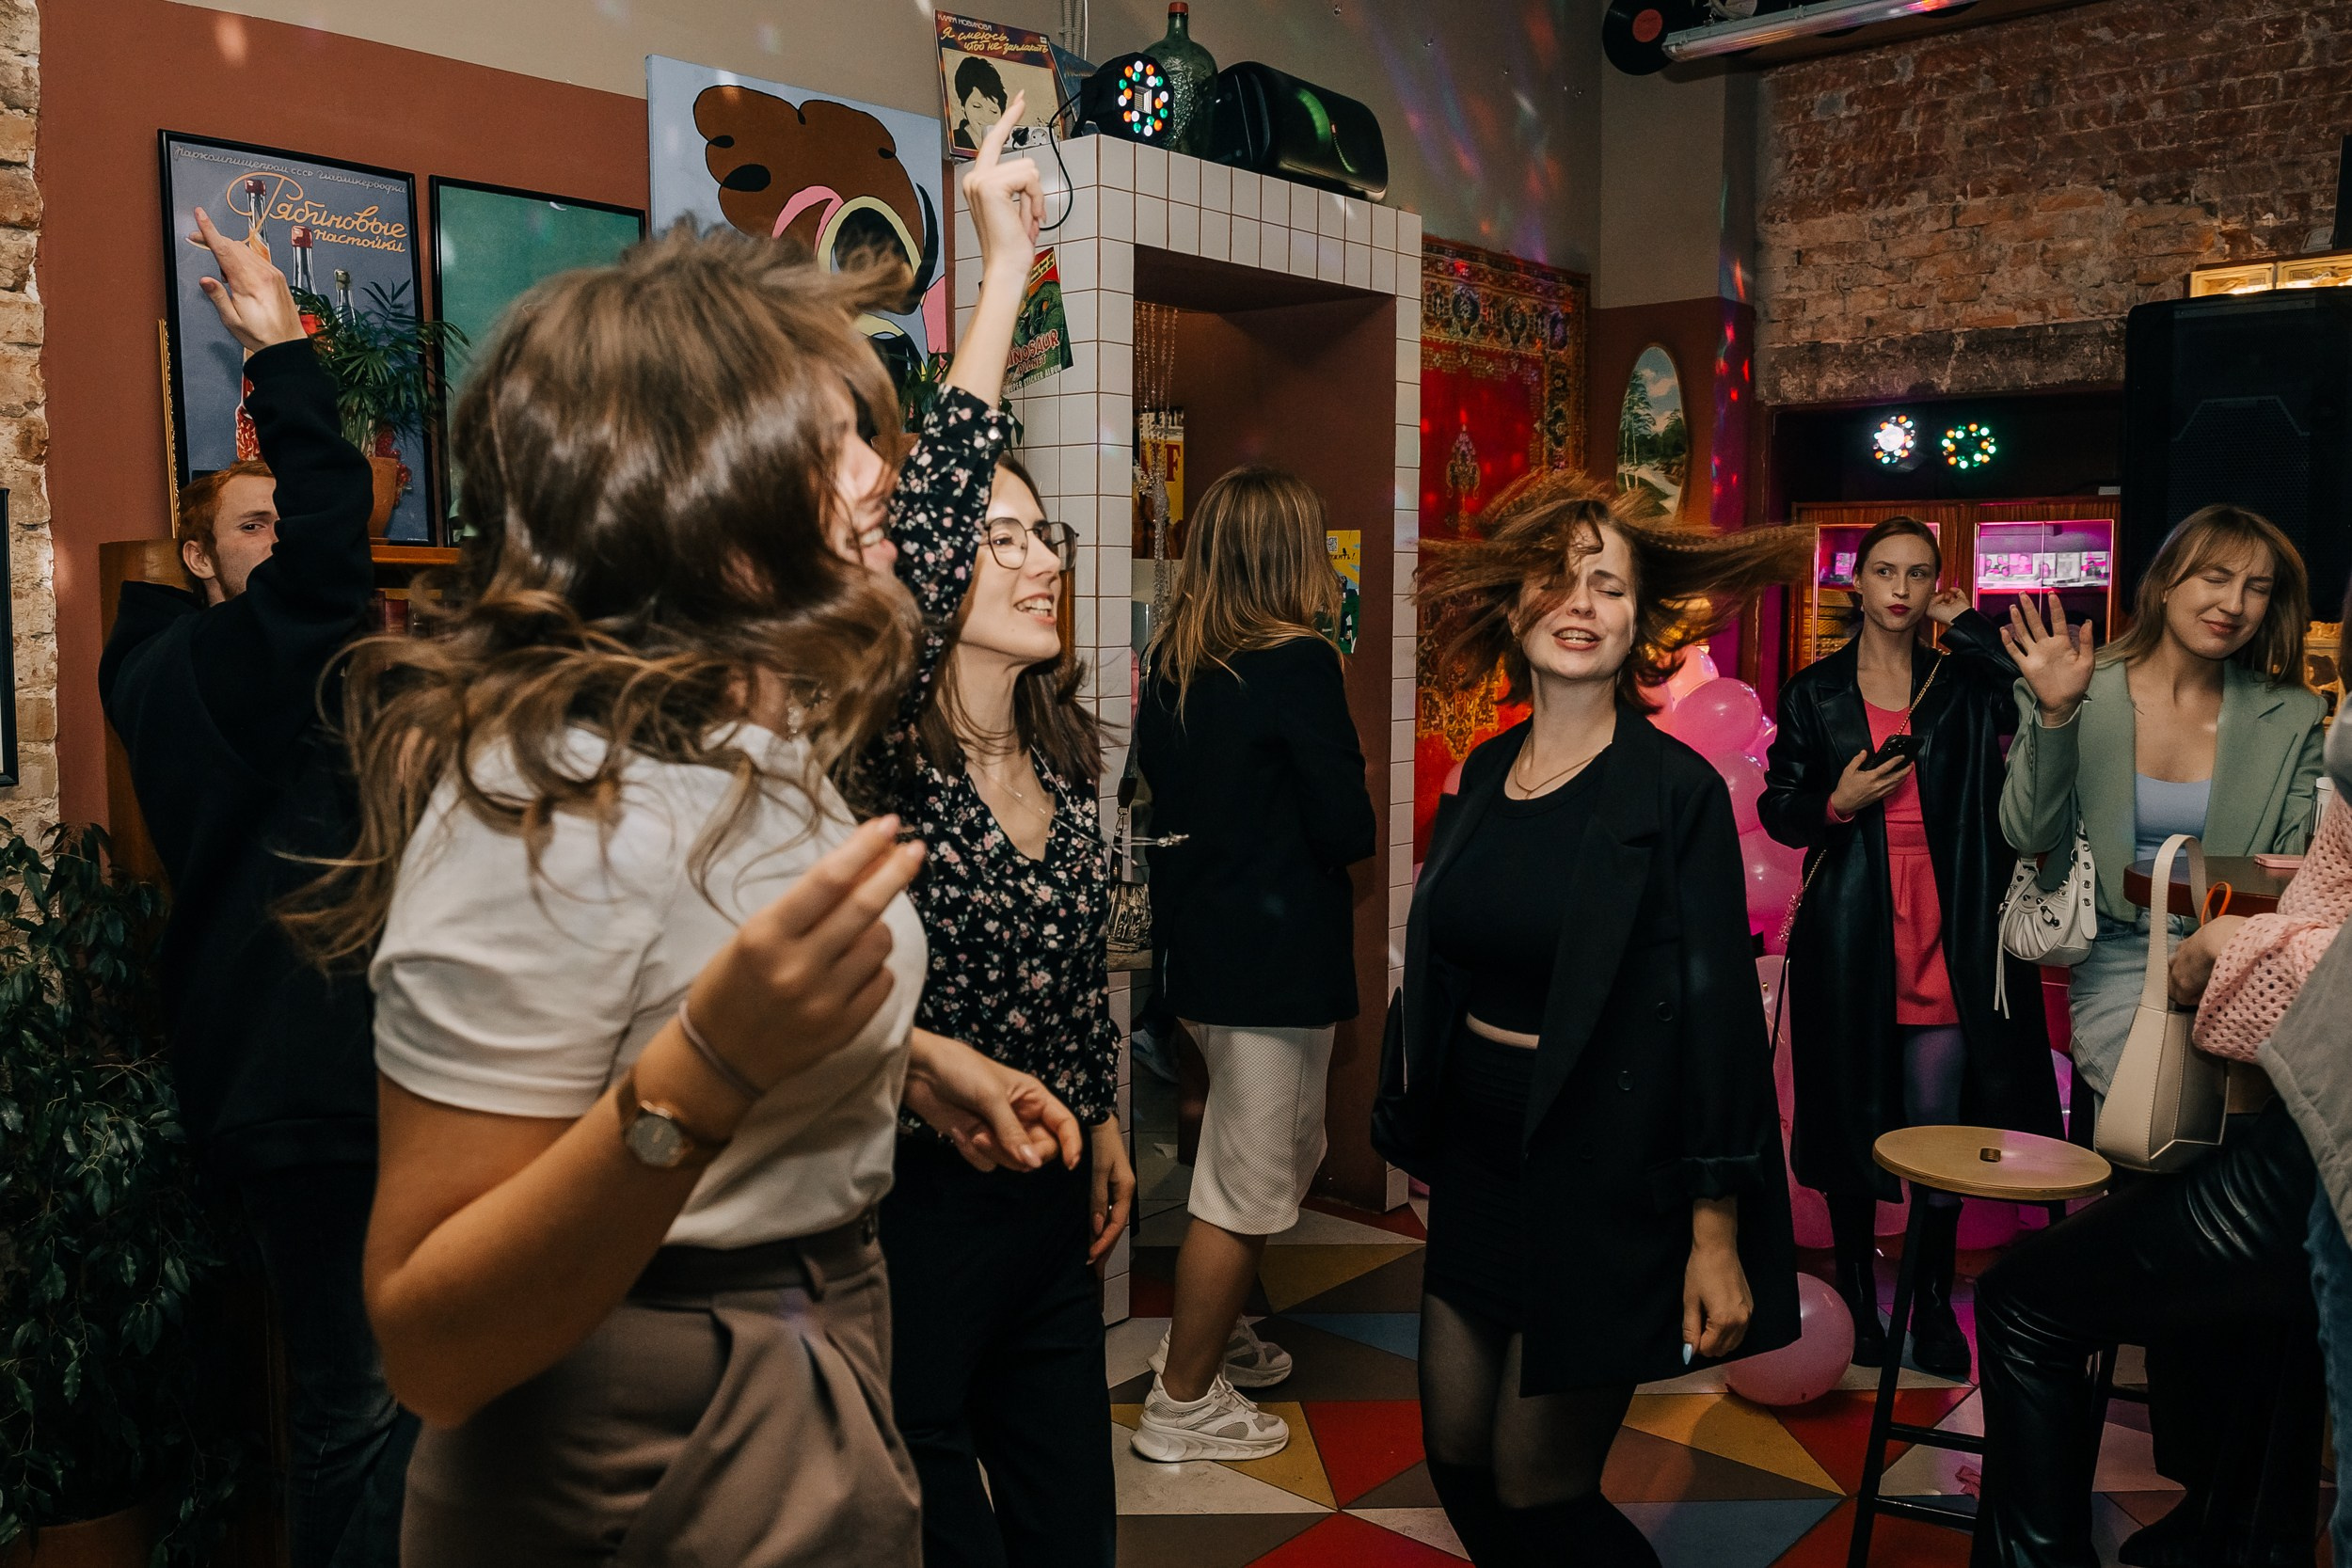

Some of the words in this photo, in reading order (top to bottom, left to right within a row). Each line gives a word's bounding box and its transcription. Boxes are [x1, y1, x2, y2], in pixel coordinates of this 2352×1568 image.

[941, 26, 955, 40] Я
[958, 19, 993, 32] НОВИКОВА
[987, 41, 1003, 52] не
[1003, 43, 1049, 55] заплакать
[291, 167, 313, 177] СССР
[185, 171, 407, 250] Рябиновые
[313, 228, 406, 253] настойки
[1007, 328, 1059, 368] INOSAUR
[1017, 353, 1047, 377] PLANET
[1023, 371, 1045, 388] STICKER
[1044, 362, 1062, 379] ALBUM
